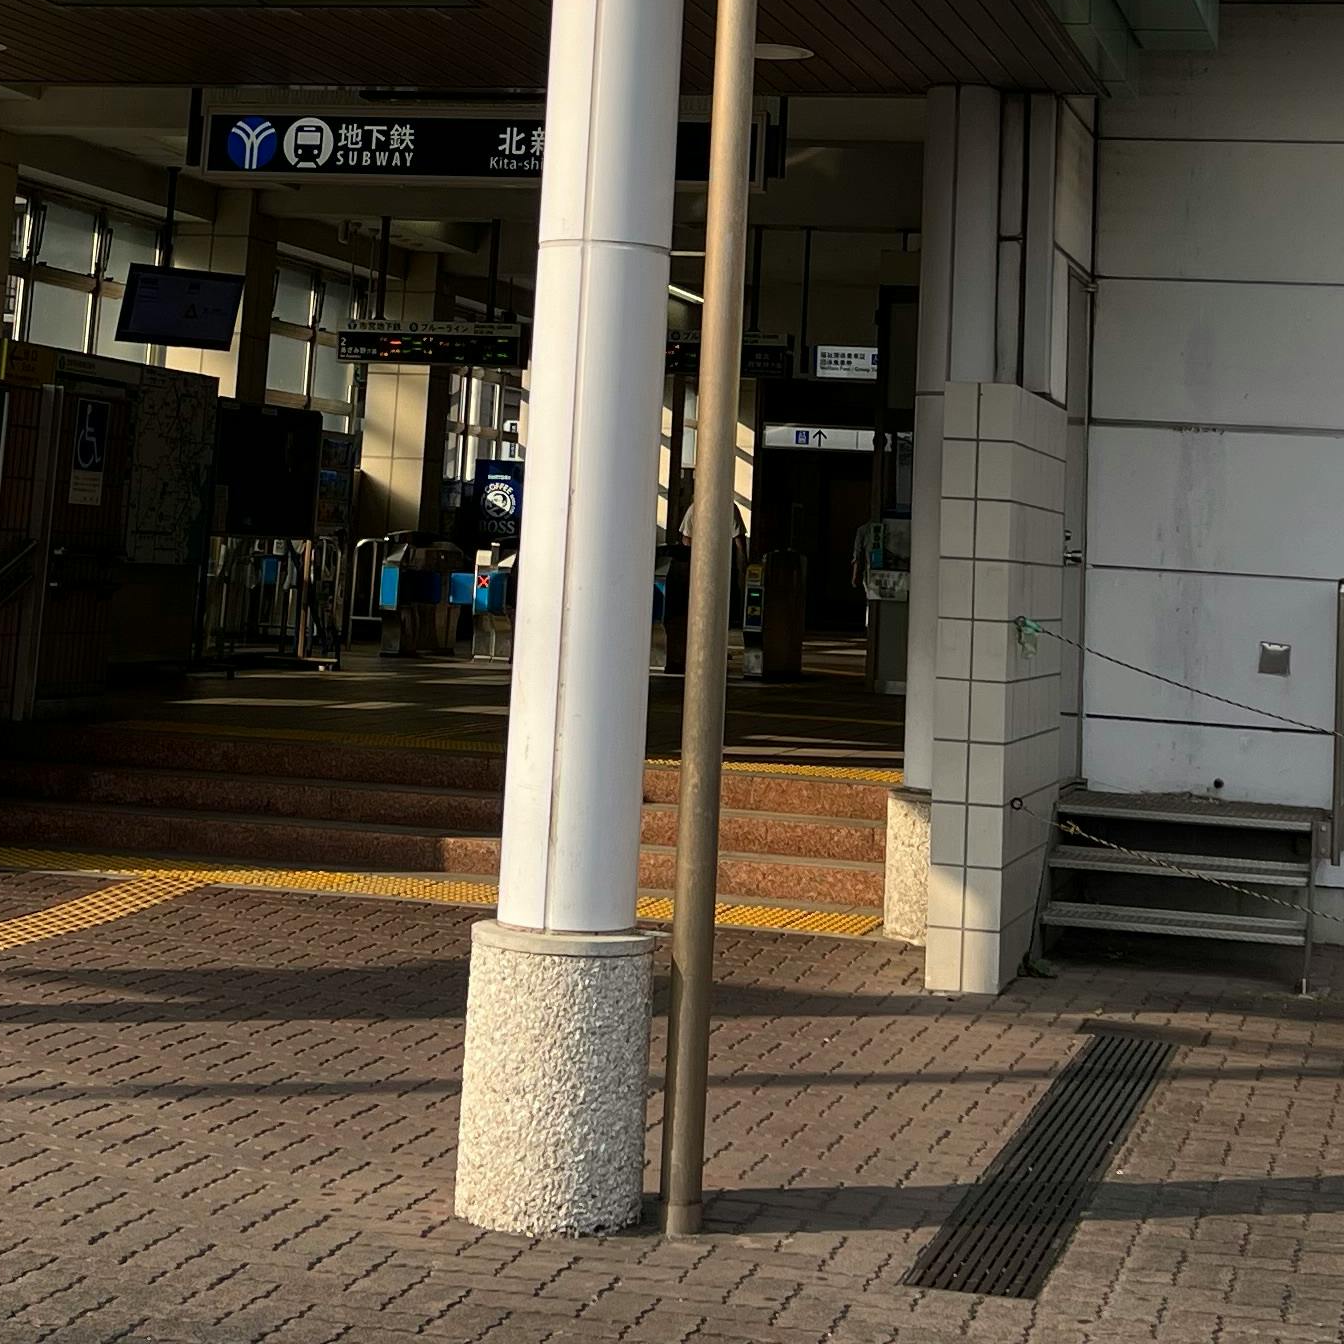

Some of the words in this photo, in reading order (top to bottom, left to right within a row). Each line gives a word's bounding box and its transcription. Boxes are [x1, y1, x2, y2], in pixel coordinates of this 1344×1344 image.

[337, 123, 415, 150] 地下鉄
[336, 150, 414, 167] SUBWAY
